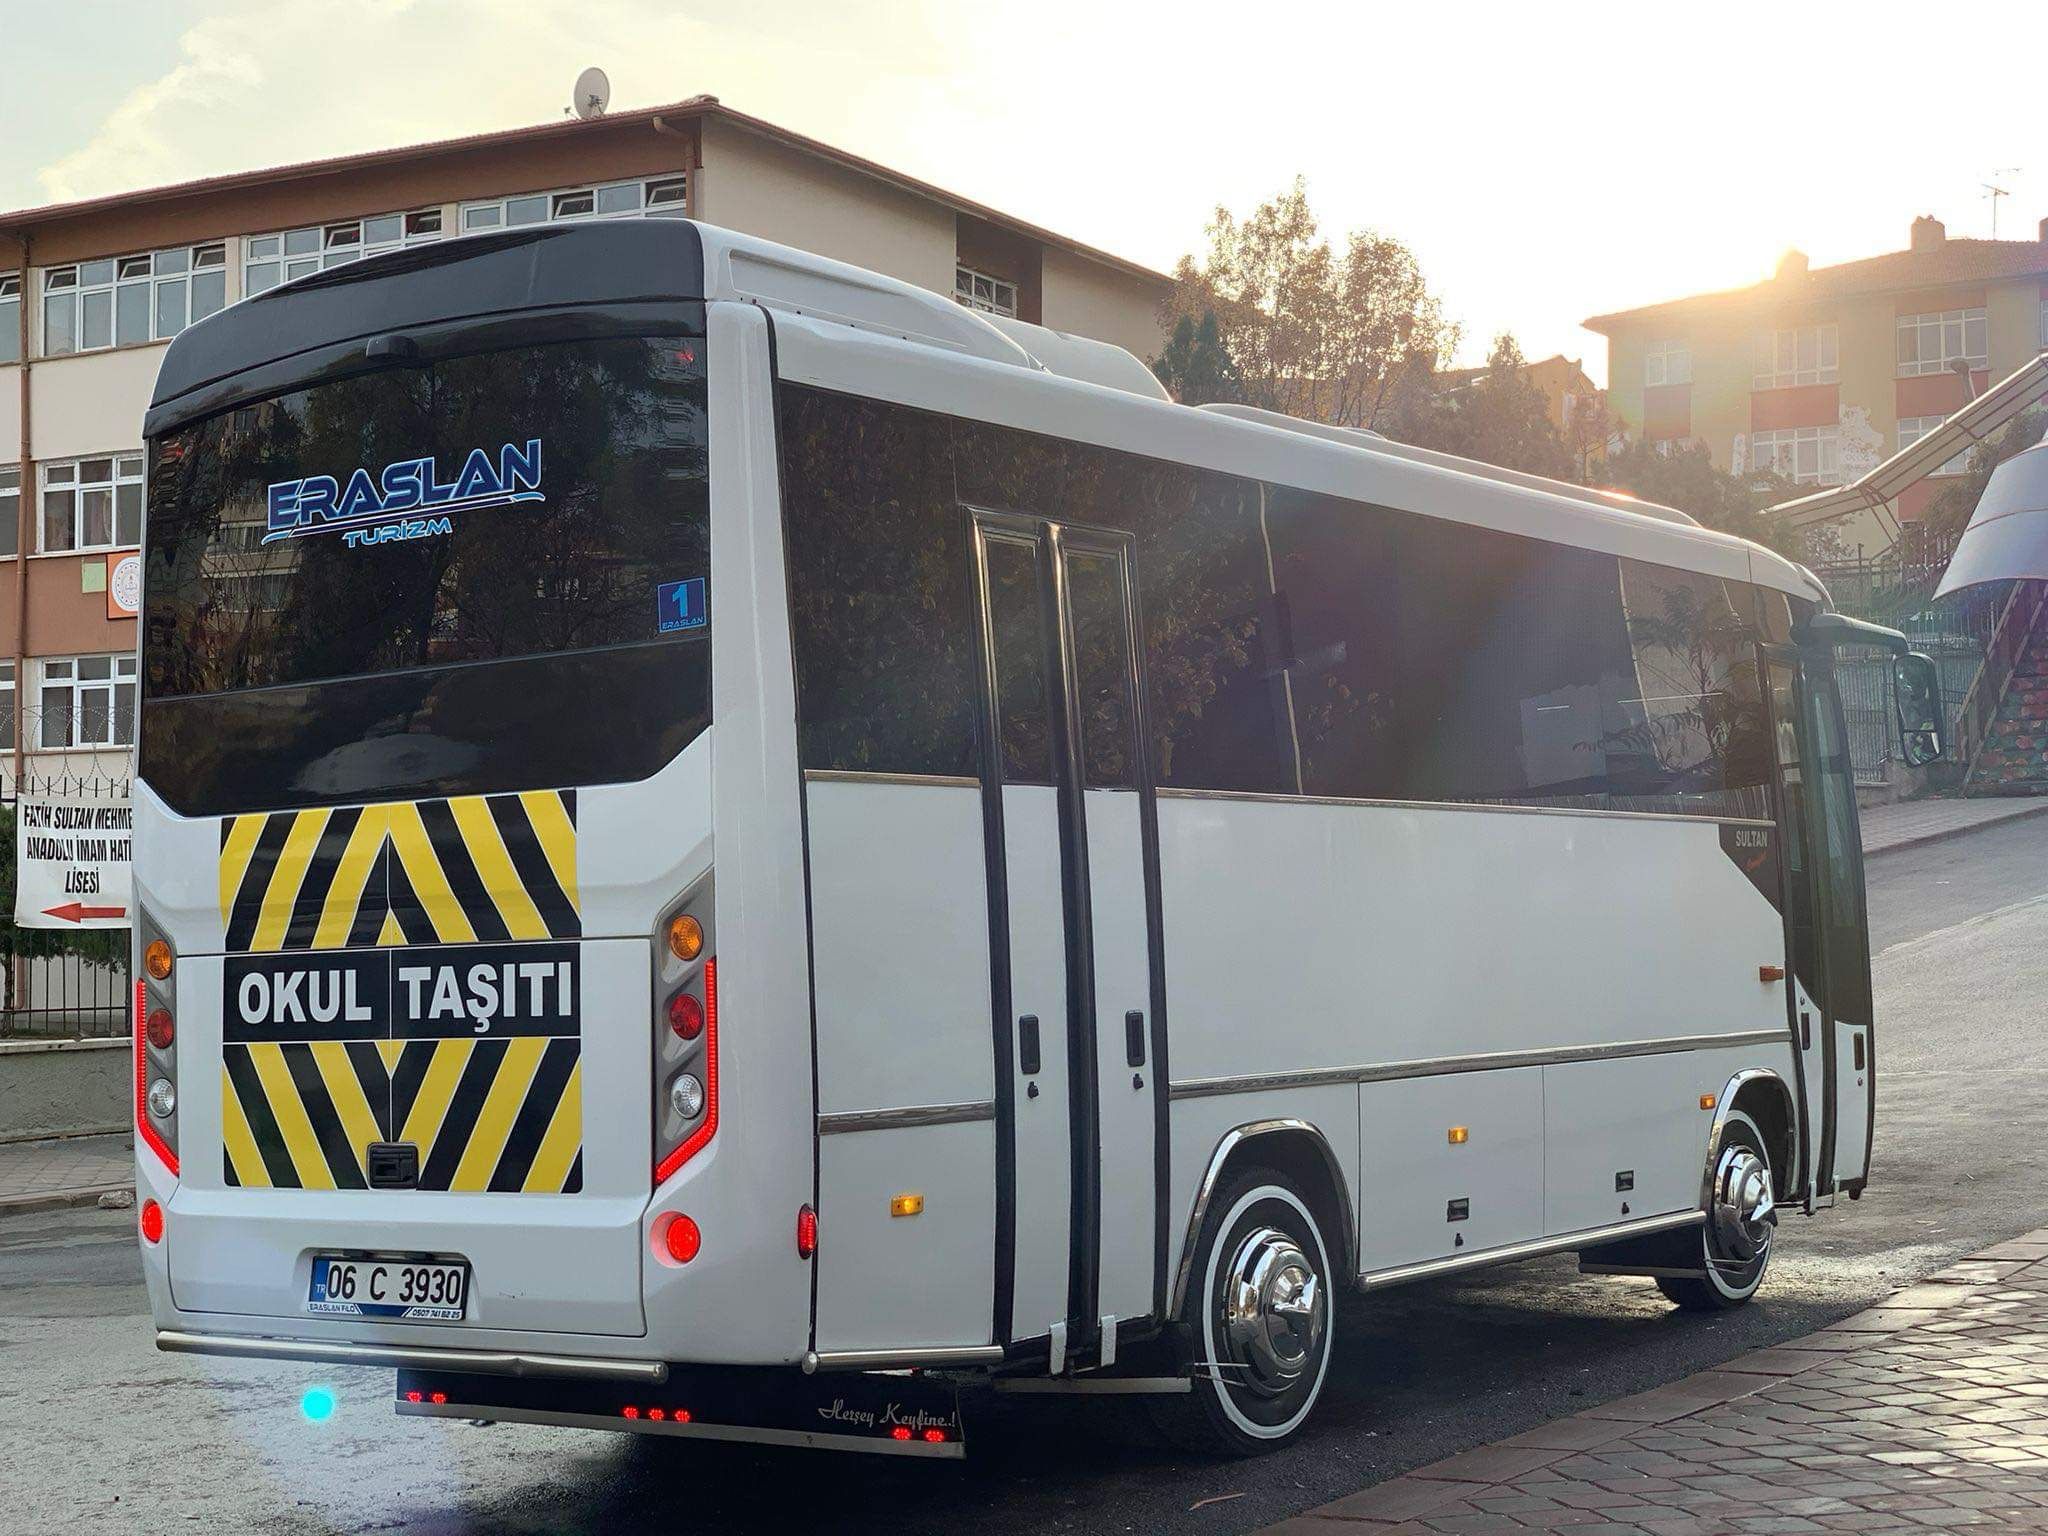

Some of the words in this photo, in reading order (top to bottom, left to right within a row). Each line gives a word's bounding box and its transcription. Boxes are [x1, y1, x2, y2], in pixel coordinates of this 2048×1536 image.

[267, 438, 542, 531] ERASLAN
[342, 516, 453, 548] TURİZM
[672, 583, 688, 617] 1
[662, 616, 704, 629] ERASLAN
[24, 801, 52, 828] FATİH
[54, 806, 94, 830] SULTAN
[26, 836, 74, 861] ANADOLU
[75, 834, 108, 862] İMAM
[1735, 830, 1768, 847] SULTAN
[65, 866, 100, 894] LİSESİ
[238, 969, 372, 1025] OKUL
[399, 961, 572, 1033] TAŞITI
[315, 1283, 326, 1294] TR
[327, 1264, 357, 1300] 06
[369, 1266, 388, 1301] C
[398, 1267, 462, 1305] 3930
[309, 1303, 340, 1313] ERASLAN
